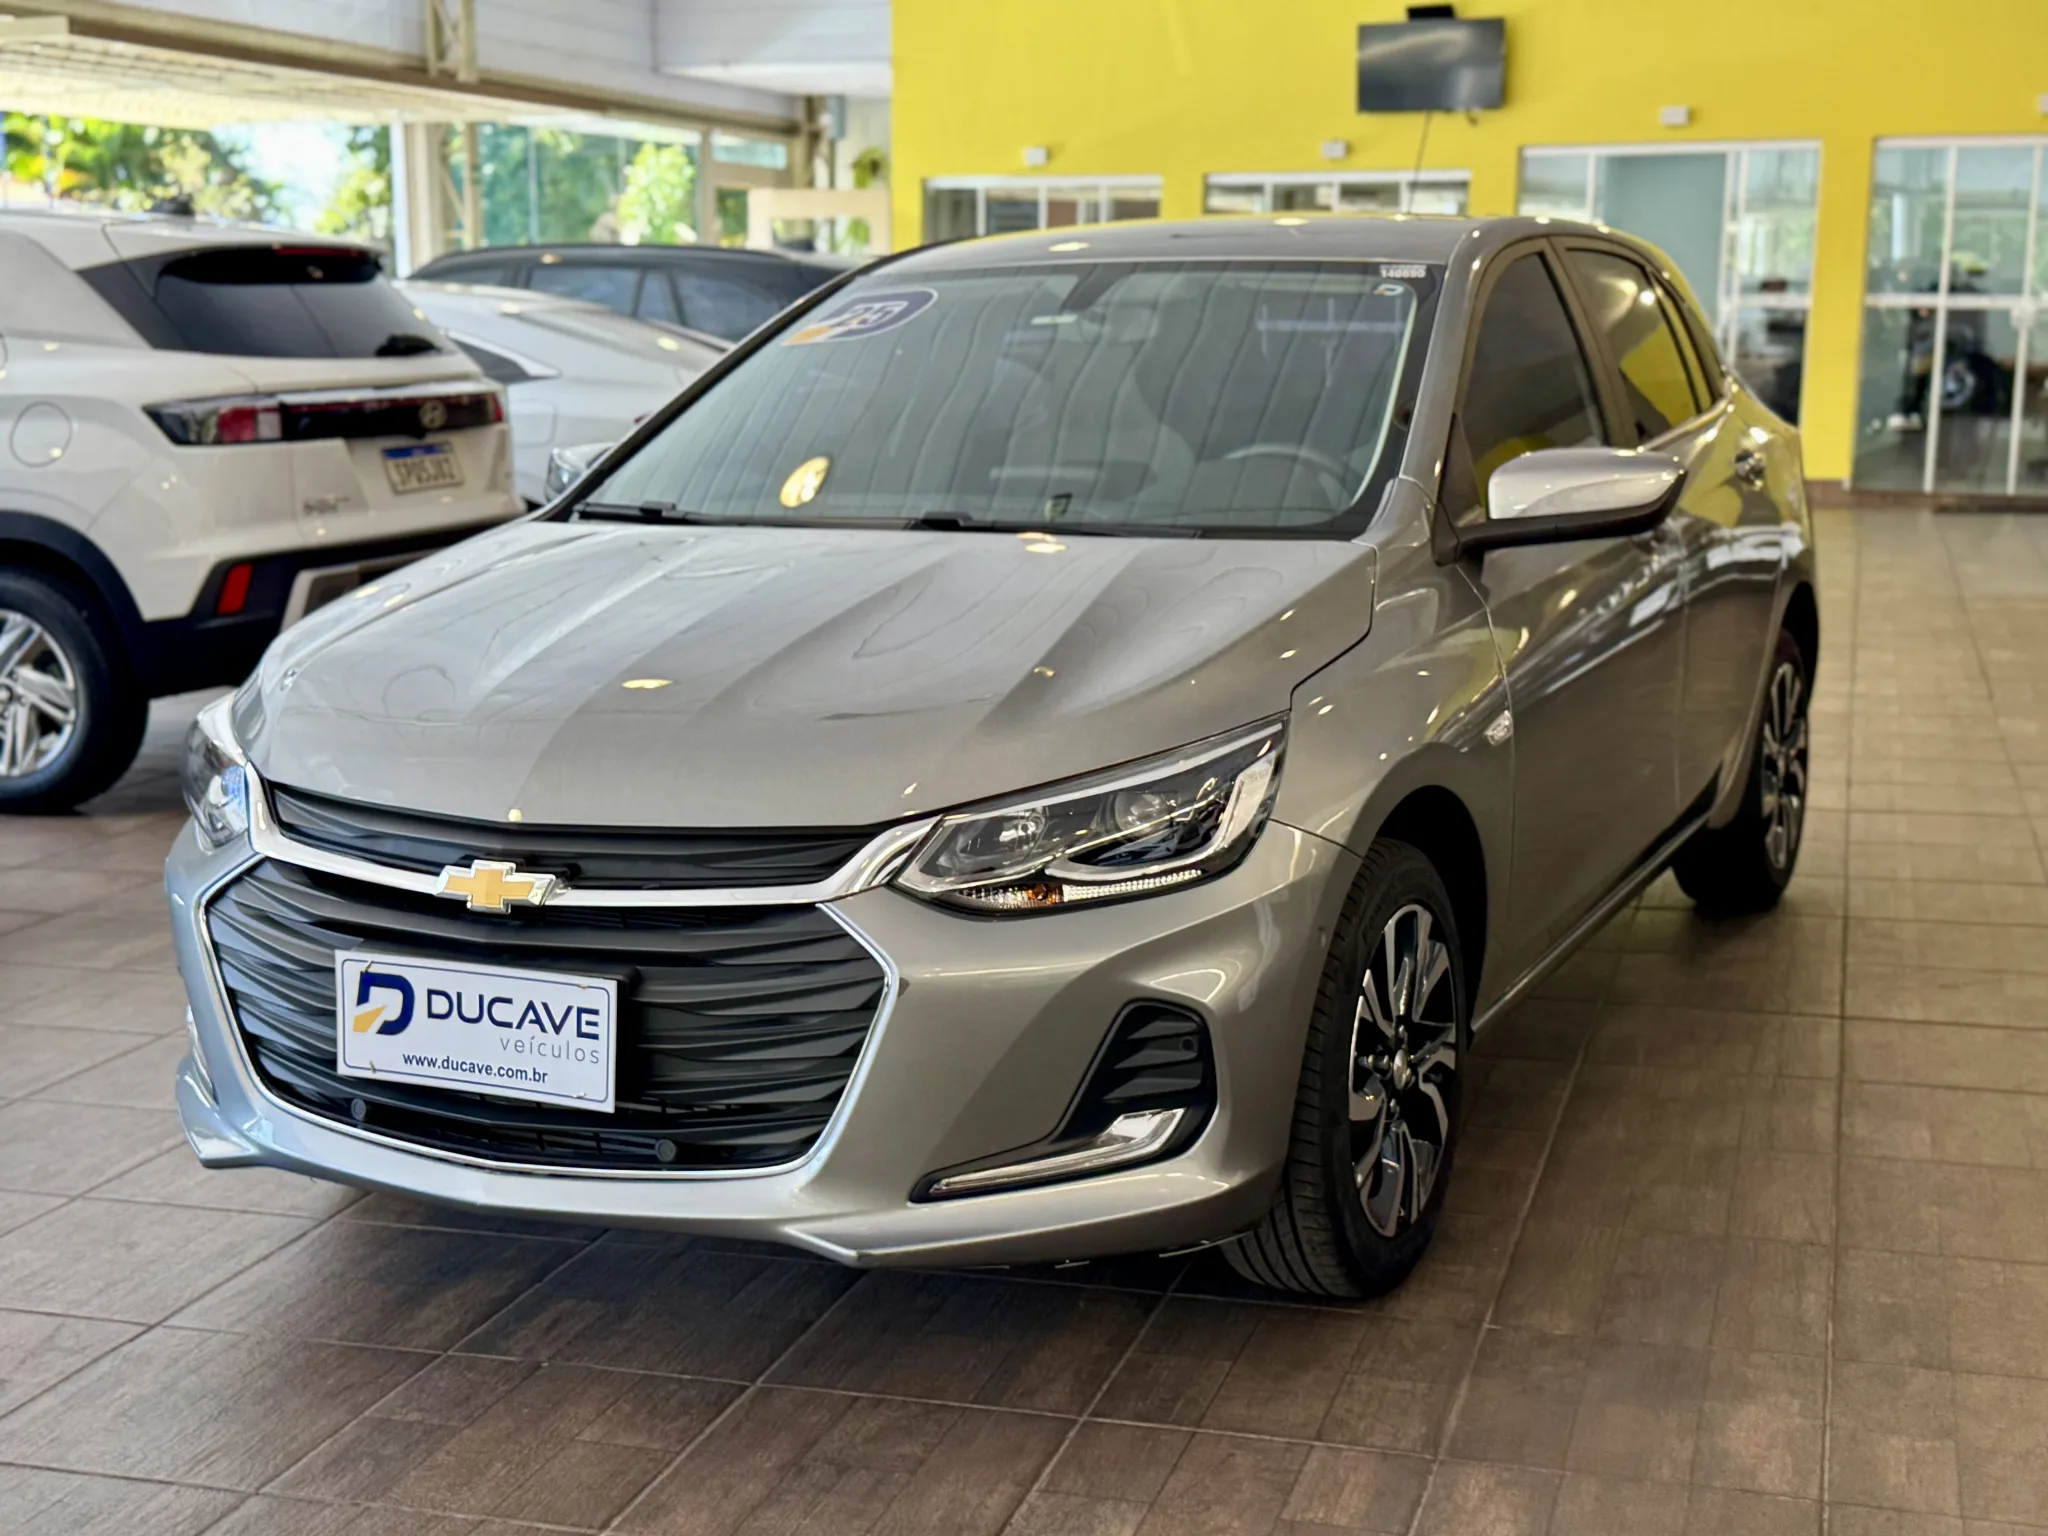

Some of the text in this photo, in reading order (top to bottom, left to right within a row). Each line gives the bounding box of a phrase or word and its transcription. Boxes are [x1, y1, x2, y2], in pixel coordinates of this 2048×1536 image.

[427, 988, 600, 1041] DUCAVE
[500, 1035, 600, 1064] veículos
[403, 1053, 548, 1084] www.ducave.com.br
